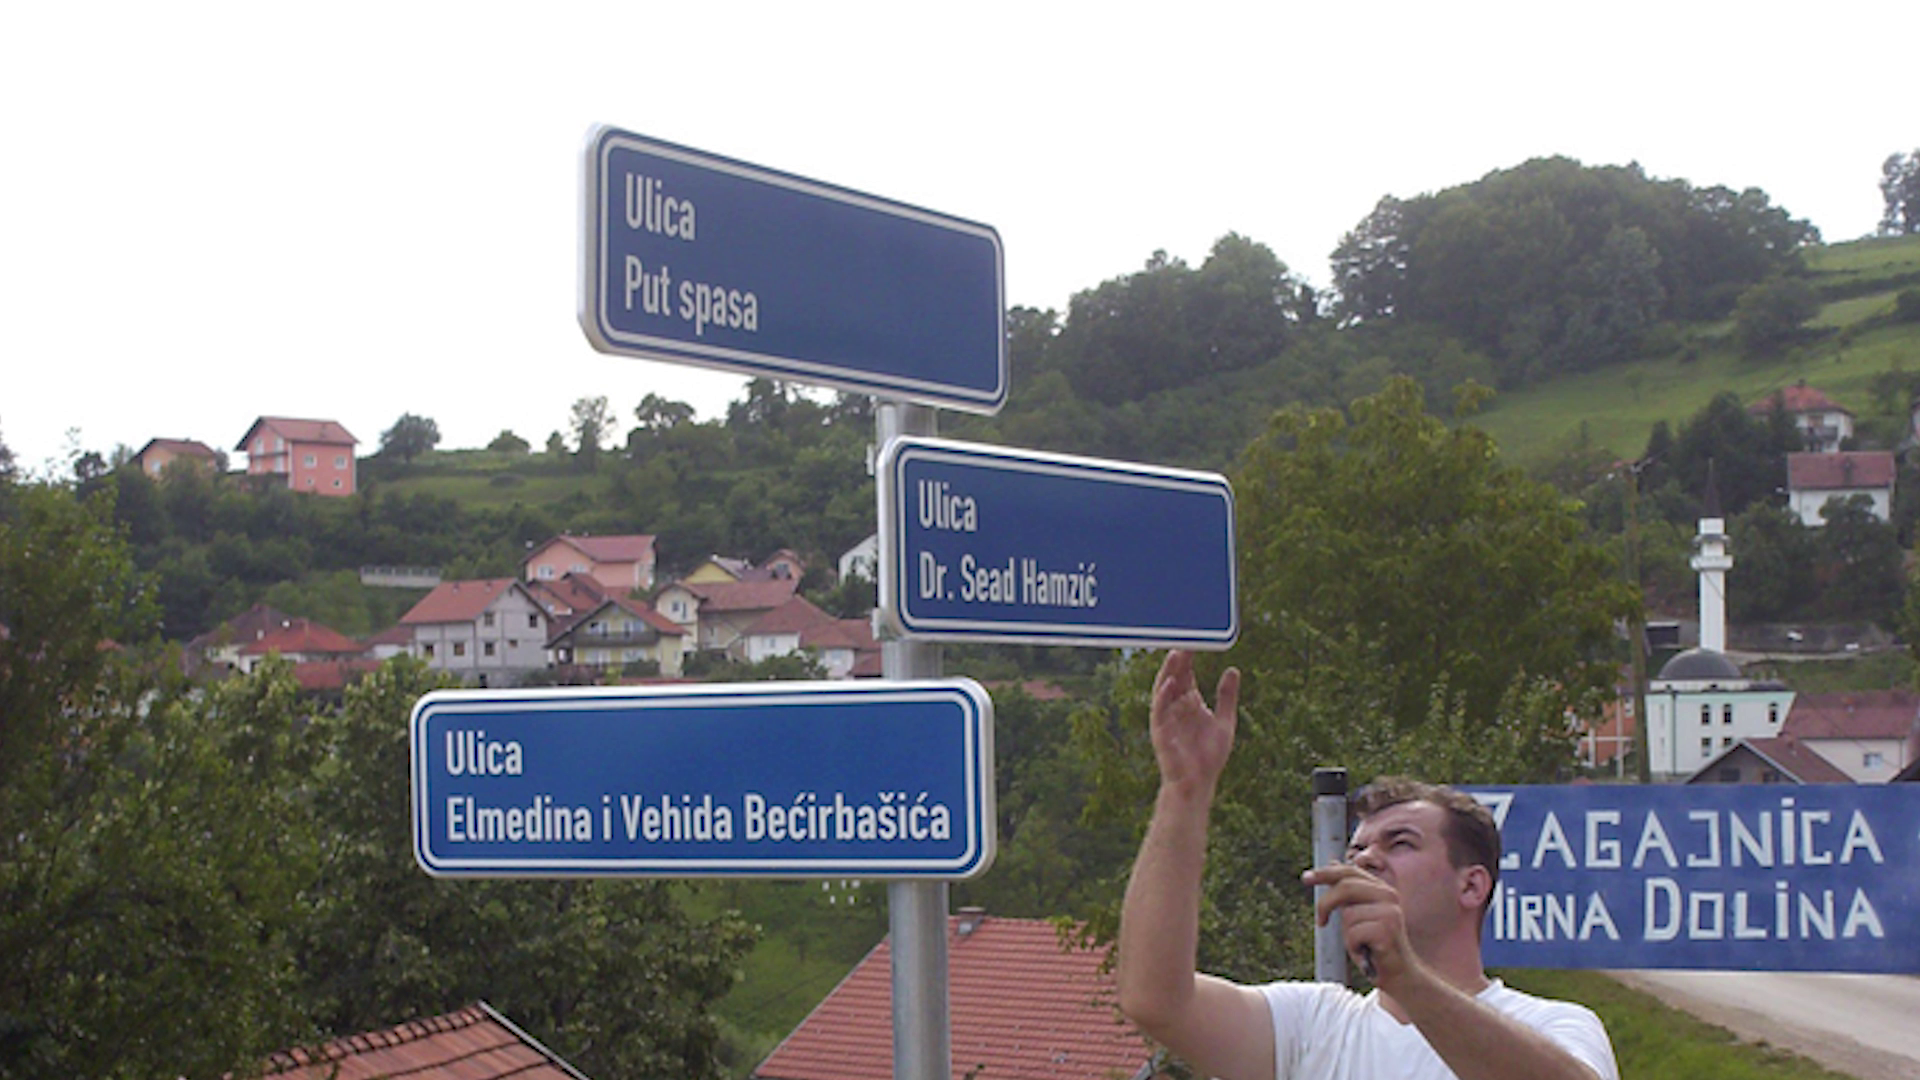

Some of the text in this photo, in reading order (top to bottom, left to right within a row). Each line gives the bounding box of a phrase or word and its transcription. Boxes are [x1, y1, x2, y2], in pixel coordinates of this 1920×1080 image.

[625, 173, 696, 241] Ulica
[625, 255, 758, 335] Put spasa
[918, 479, 978, 532] Ulica
[919, 551, 1099, 607] Dr. Sead Hamzić
[445, 730, 523, 776] Ulica
[447, 791, 951, 842] Elmedina i Vehida Bećirbašića
